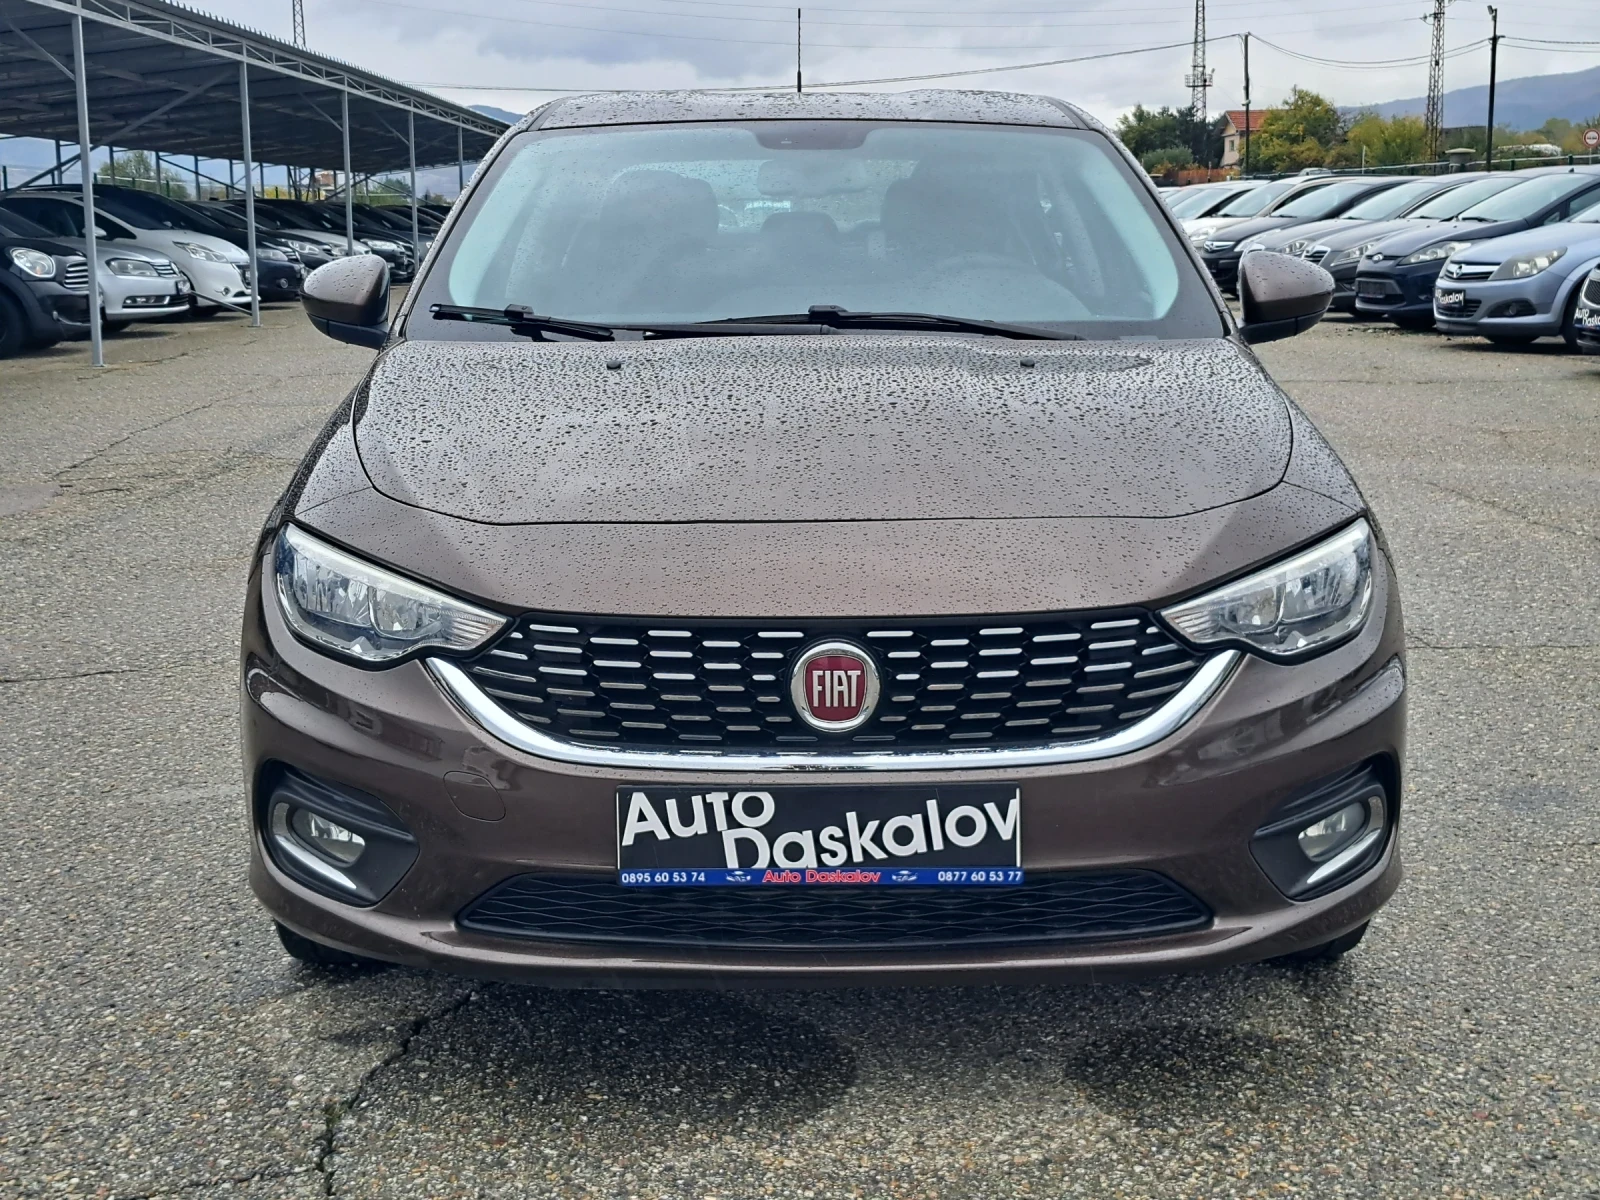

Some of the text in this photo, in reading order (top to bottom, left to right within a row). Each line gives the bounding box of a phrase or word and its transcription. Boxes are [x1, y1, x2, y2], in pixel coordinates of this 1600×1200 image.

[812, 670, 861, 707] FIAT
[622, 791, 776, 846] Auto
[722, 799, 1018, 869] Daskalov
[621, 872, 706, 883] 0895 60 53 74
[762, 869, 881, 883] Auto Daskalov
[938, 871, 1022, 881] 0877 60 53 77
